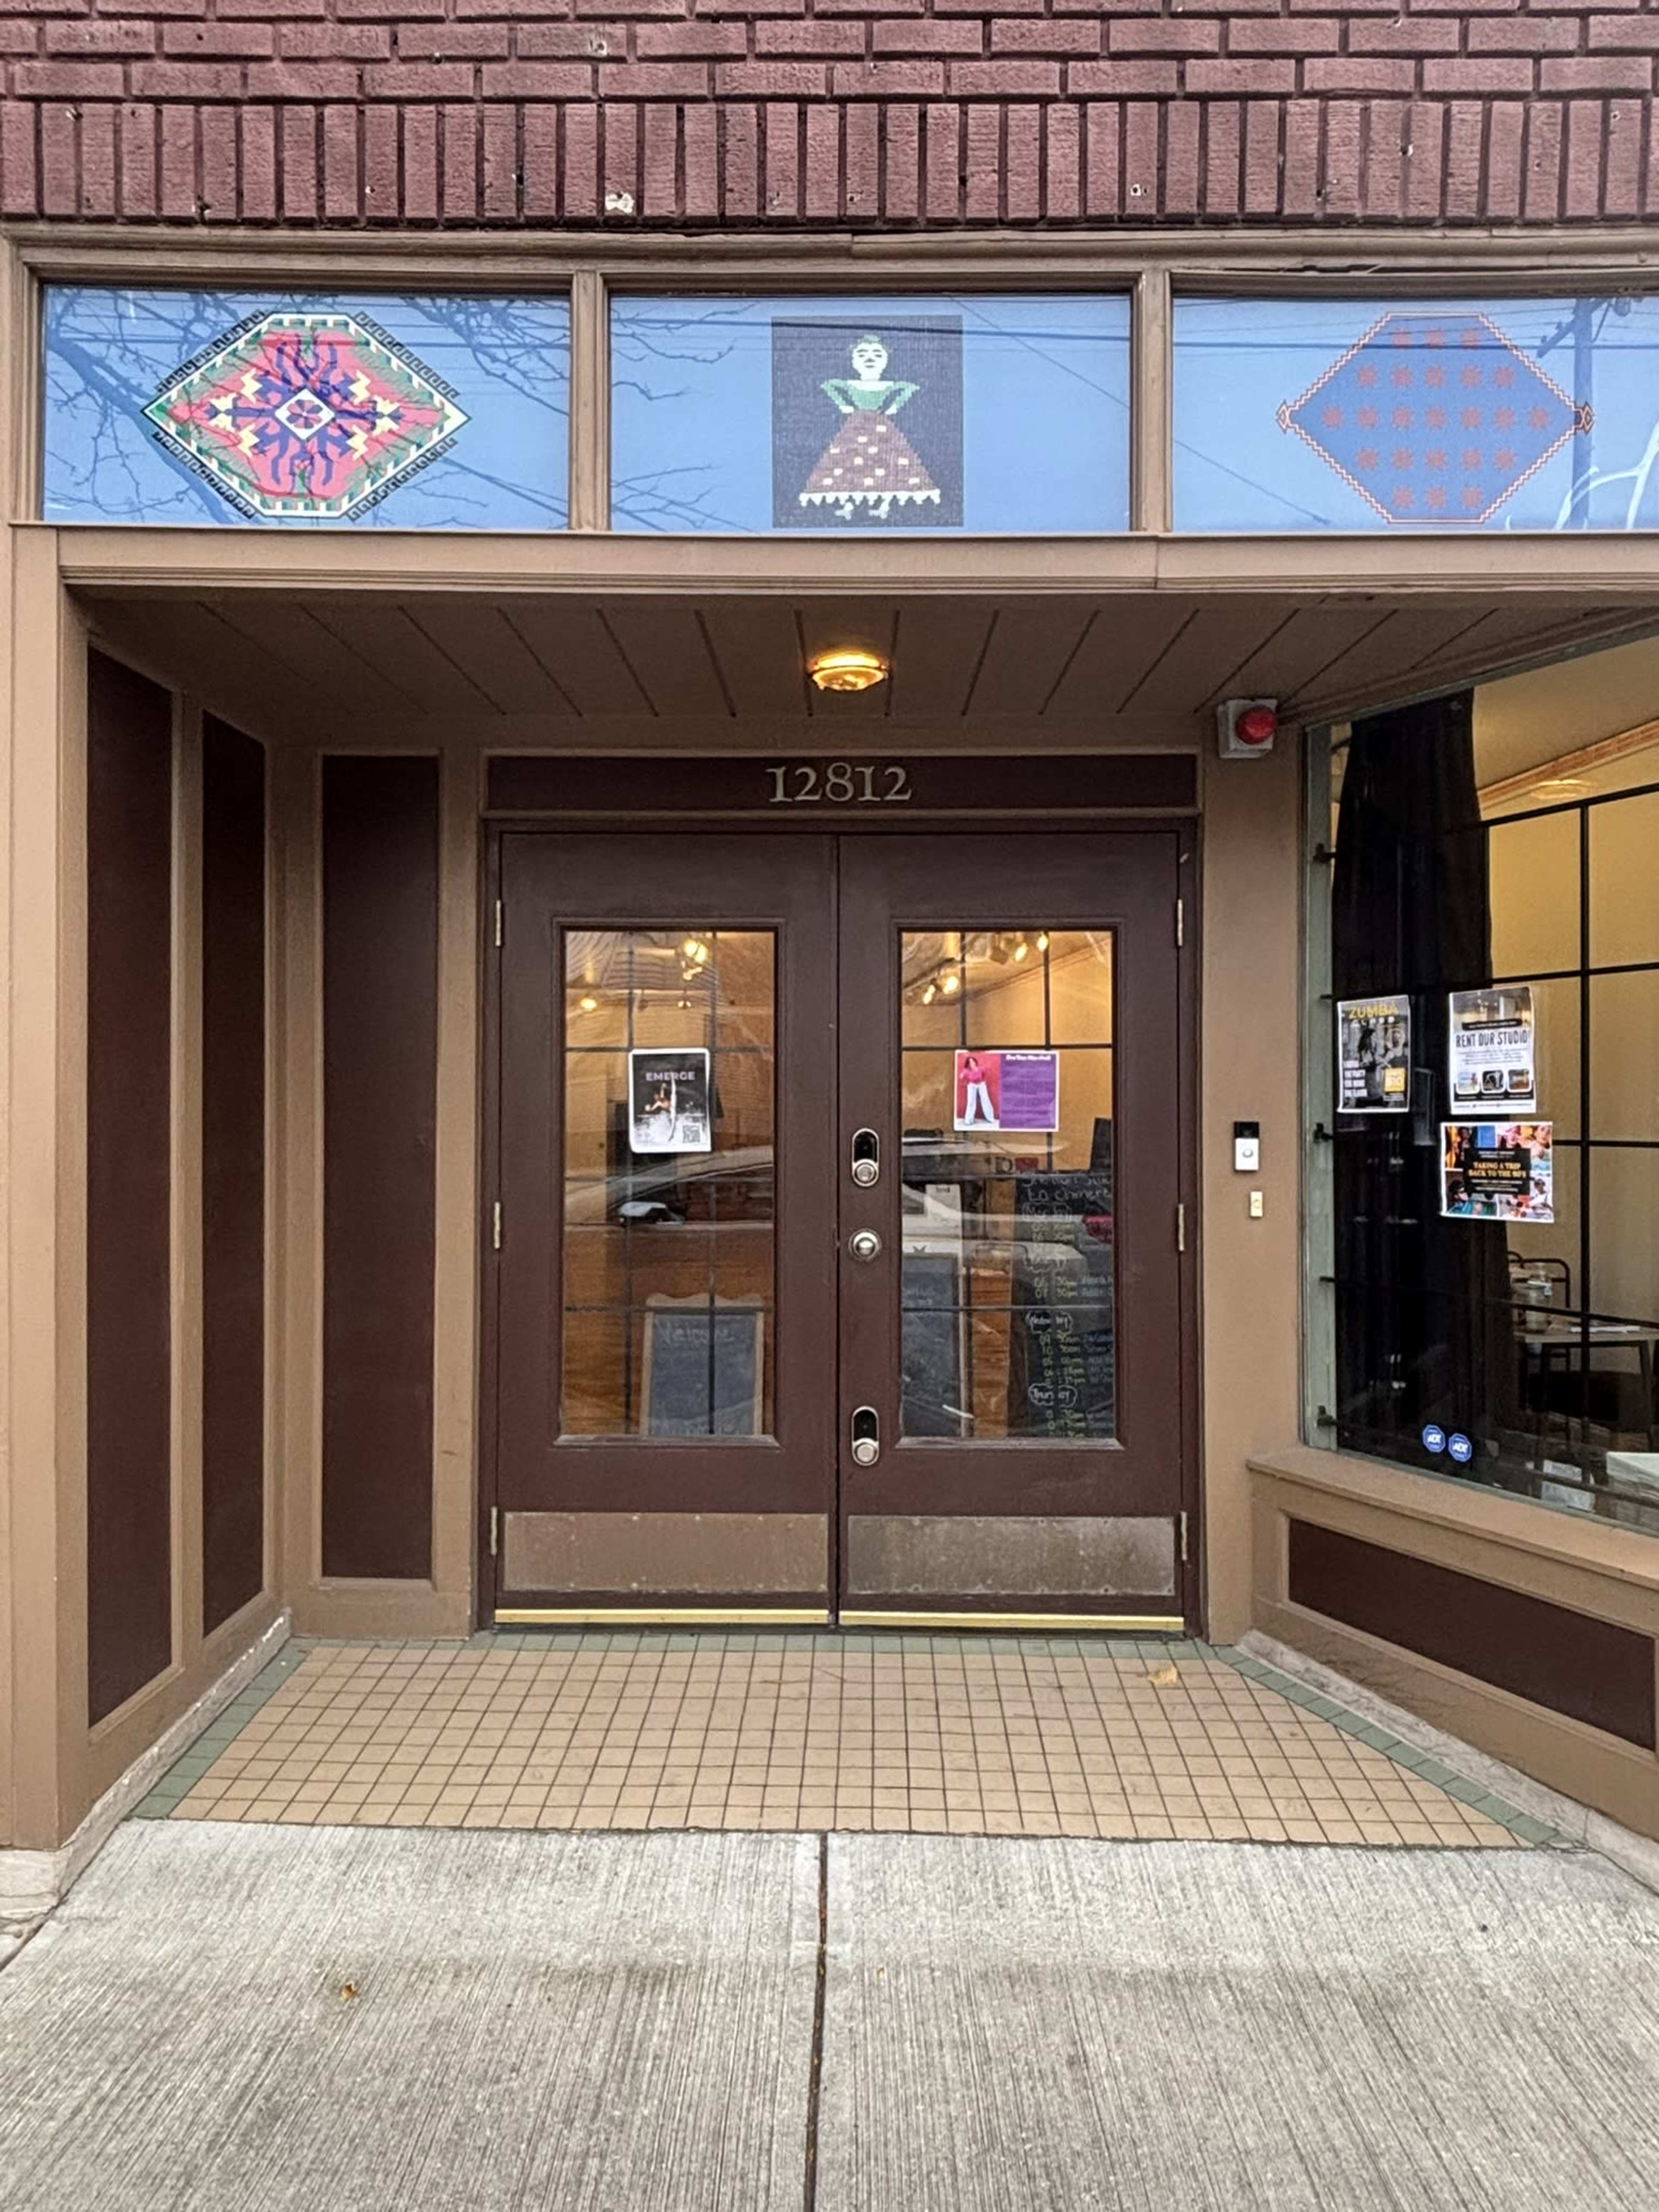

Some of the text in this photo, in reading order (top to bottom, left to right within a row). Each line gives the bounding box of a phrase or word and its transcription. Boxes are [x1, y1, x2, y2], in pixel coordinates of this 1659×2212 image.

[765, 762, 912, 802] 12812
[1348, 1003, 1399, 1020] ZUMBA
[1456, 1034, 1476, 1048] RENT
[1478, 1032, 1495, 1046] OUR
[645, 1071, 695, 1081] EMERGE
